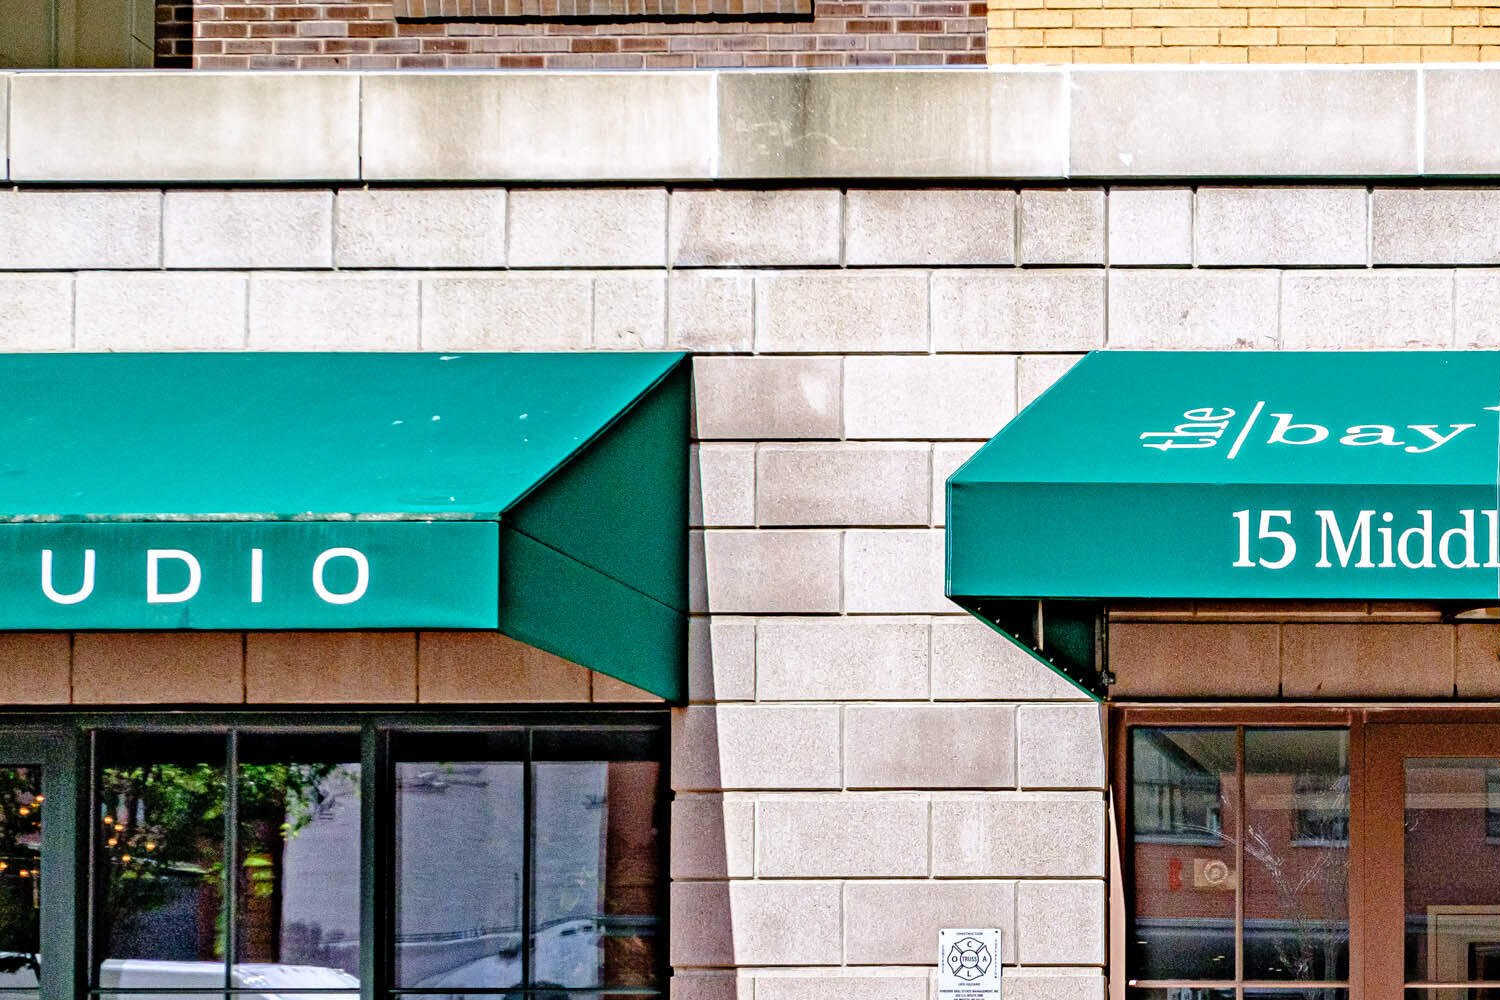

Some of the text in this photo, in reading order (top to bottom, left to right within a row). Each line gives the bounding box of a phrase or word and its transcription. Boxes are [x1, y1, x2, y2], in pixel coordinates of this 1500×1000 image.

[1140, 407, 1236, 450] the
[1267, 413, 1476, 453] bay
[1233, 509, 1297, 569] 15
[41, 547, 369, 605] UDIO
